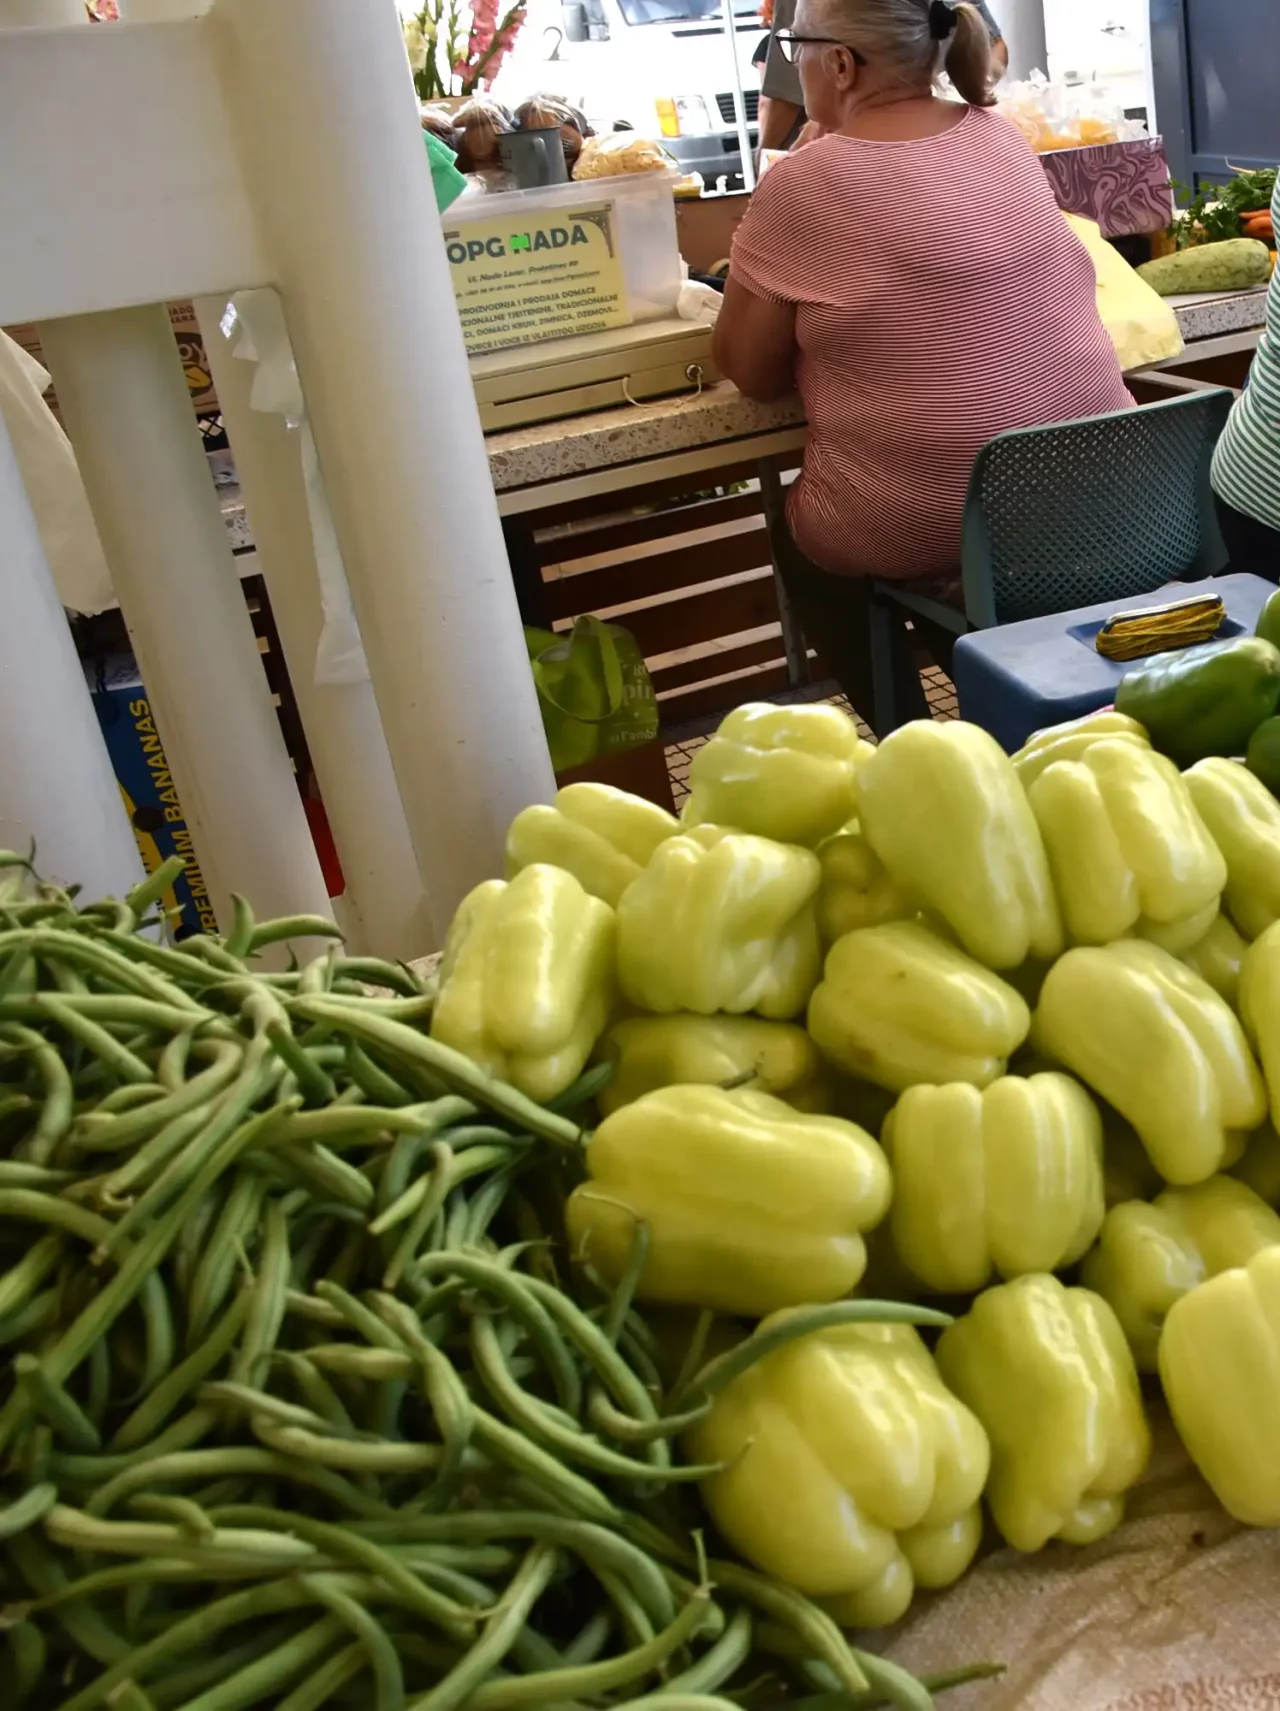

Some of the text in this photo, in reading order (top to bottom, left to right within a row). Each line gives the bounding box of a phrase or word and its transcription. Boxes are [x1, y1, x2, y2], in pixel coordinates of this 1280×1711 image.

[447, 237, 506, 264] OPG
[169, 305, 194, 316] ADO
[129, 699, 184, 822] BANANAS
[171, 829, 219, 933] REMIUM
